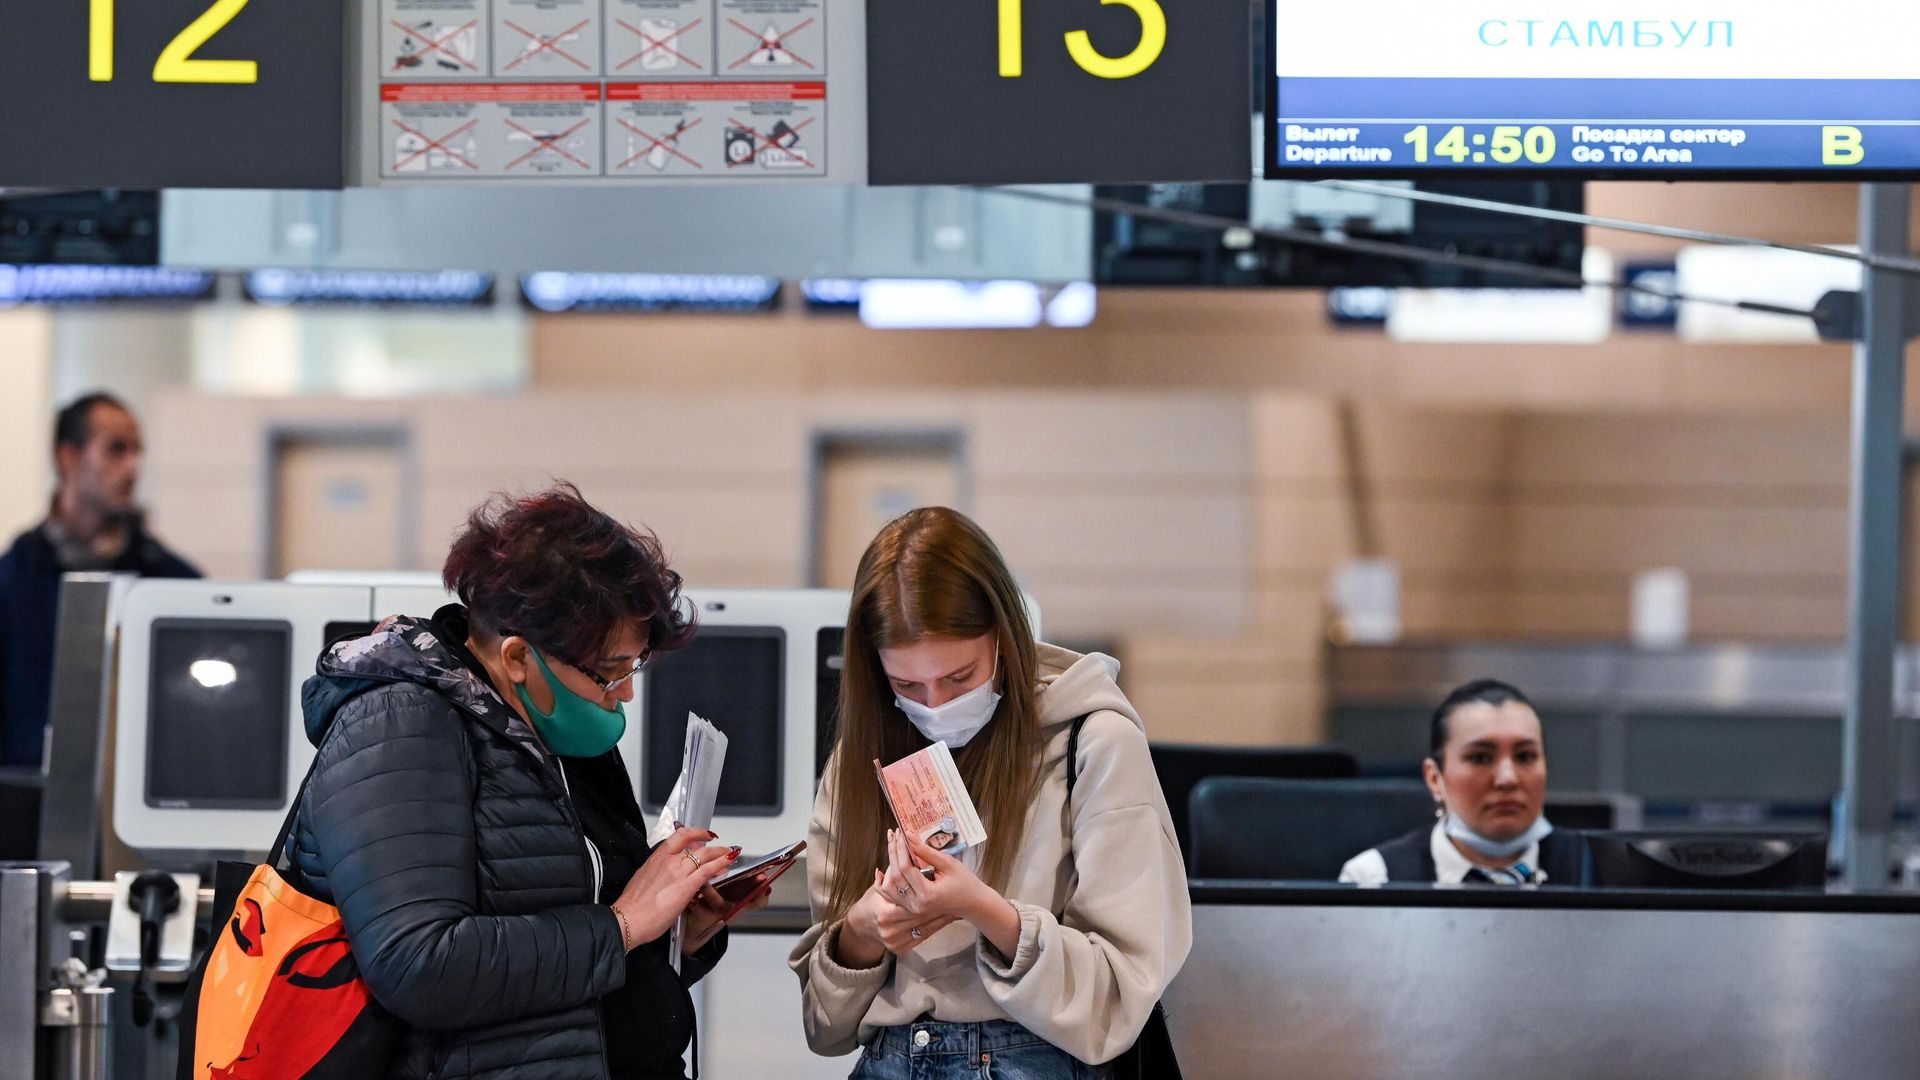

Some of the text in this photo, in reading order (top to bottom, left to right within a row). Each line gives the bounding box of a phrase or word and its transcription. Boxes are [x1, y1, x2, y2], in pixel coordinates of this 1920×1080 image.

[90, 0, 257, 83] 12
[999, 0, 1167, 79] 13
[1477, 19, 1734, 48] СТАМБУЛ
[1285, 125, 1360, 142] Вылет
[1403, 125, 1556, 164] 14:50
[1572, 126, 1746, 147] Посадка сектор
[1822, 125, 1865, 166] B
[1285, 144, 1392, 165] Departure
[1571, 145, 1693, 163] Go To Area
